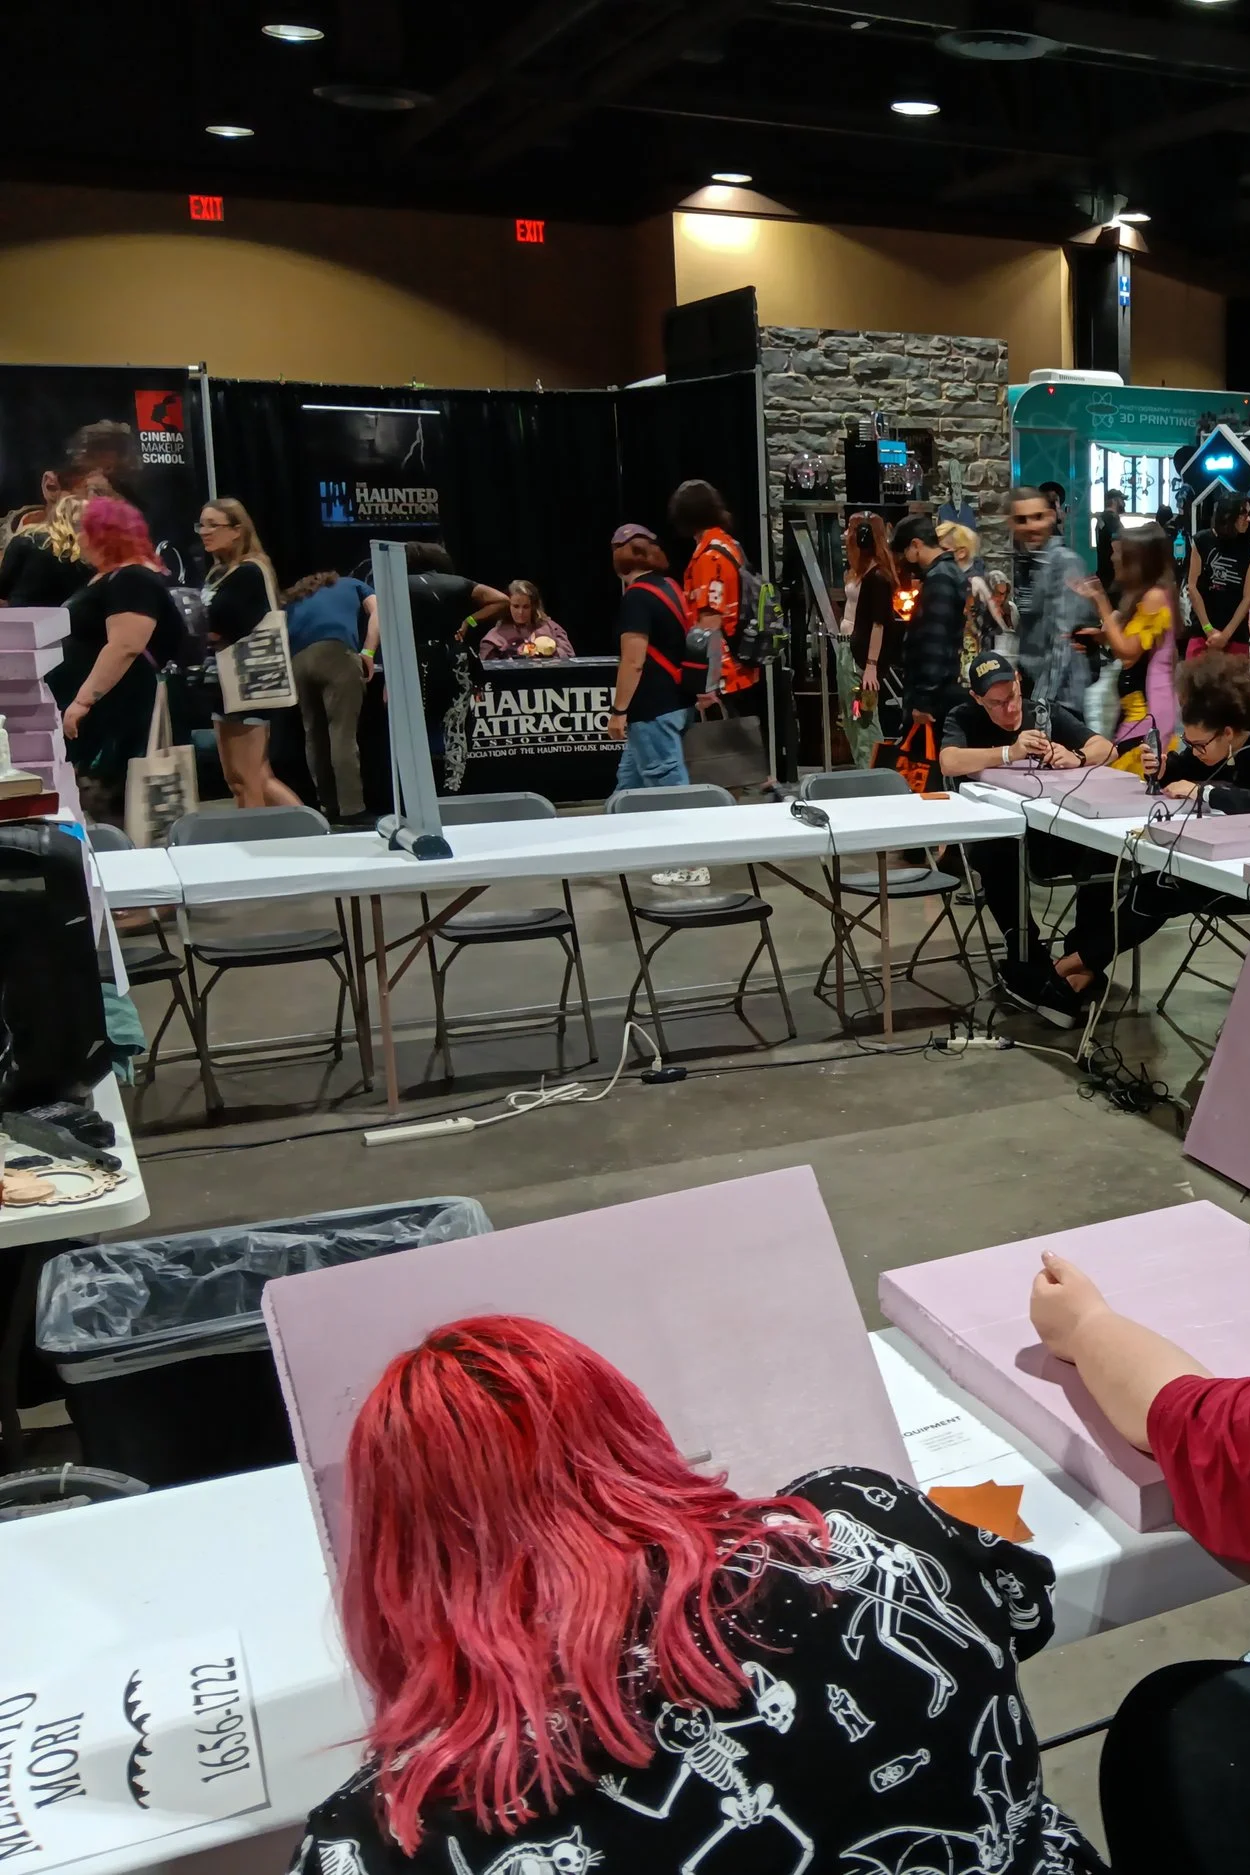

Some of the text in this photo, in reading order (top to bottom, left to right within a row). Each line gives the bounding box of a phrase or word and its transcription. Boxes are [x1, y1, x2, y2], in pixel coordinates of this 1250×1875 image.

[190, 195, 224, 221] EXIT
[516, 219, 545, 243] EXIT
[1119, 413, 1197, 428] 3D PRINTING
[140, 431, 184, 442] CINEMA
[141, 442, 184, 453] MAKEUP
[142, 453, 185, 465] SCHOOL
[355, 487, 439, 503] HAUNTED
[357, 503, 439, 515] ATTRACTION
[471, 686, 617, 718] HAUNTE
[472, 712, 613, 738] ATTRACTIO
[472, 733, 604, 748] ASSOCIATI
[520, 747, 535, 755] THE
[537, 744, 572, 755] HAUNTED
[574, 744, 598, 752] HOUSE
[599, 743, 629, 751] INDUST
[902, 1415, 961, 1438] QUIPMENT
[190, 1656, 251, 1784] 1656-1722
[27, 1711, 87, 1811] MORI
